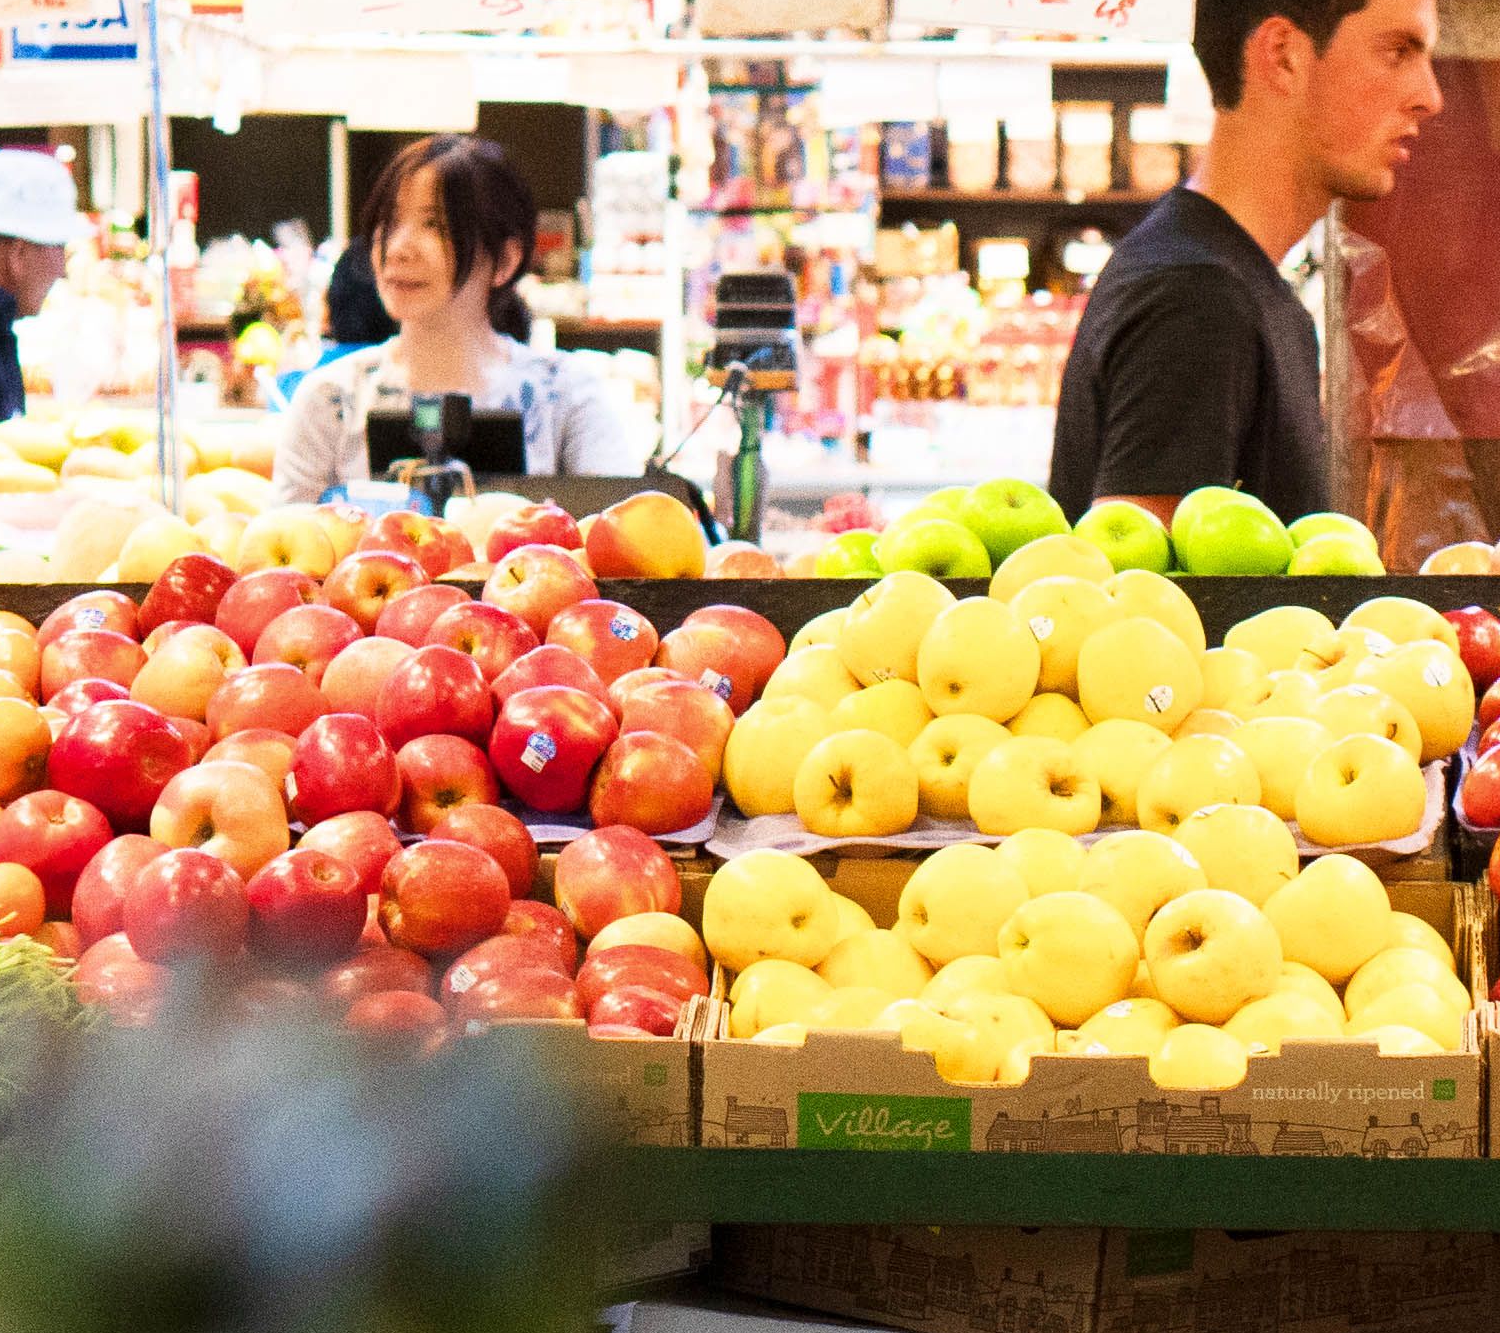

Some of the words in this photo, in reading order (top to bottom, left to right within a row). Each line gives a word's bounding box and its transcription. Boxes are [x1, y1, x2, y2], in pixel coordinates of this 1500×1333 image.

[1252, 1081, 1344, 1105] naturally
[1348, 1079, 1426, 1105] ripened
[815, 1105, 956, 1150] Village
